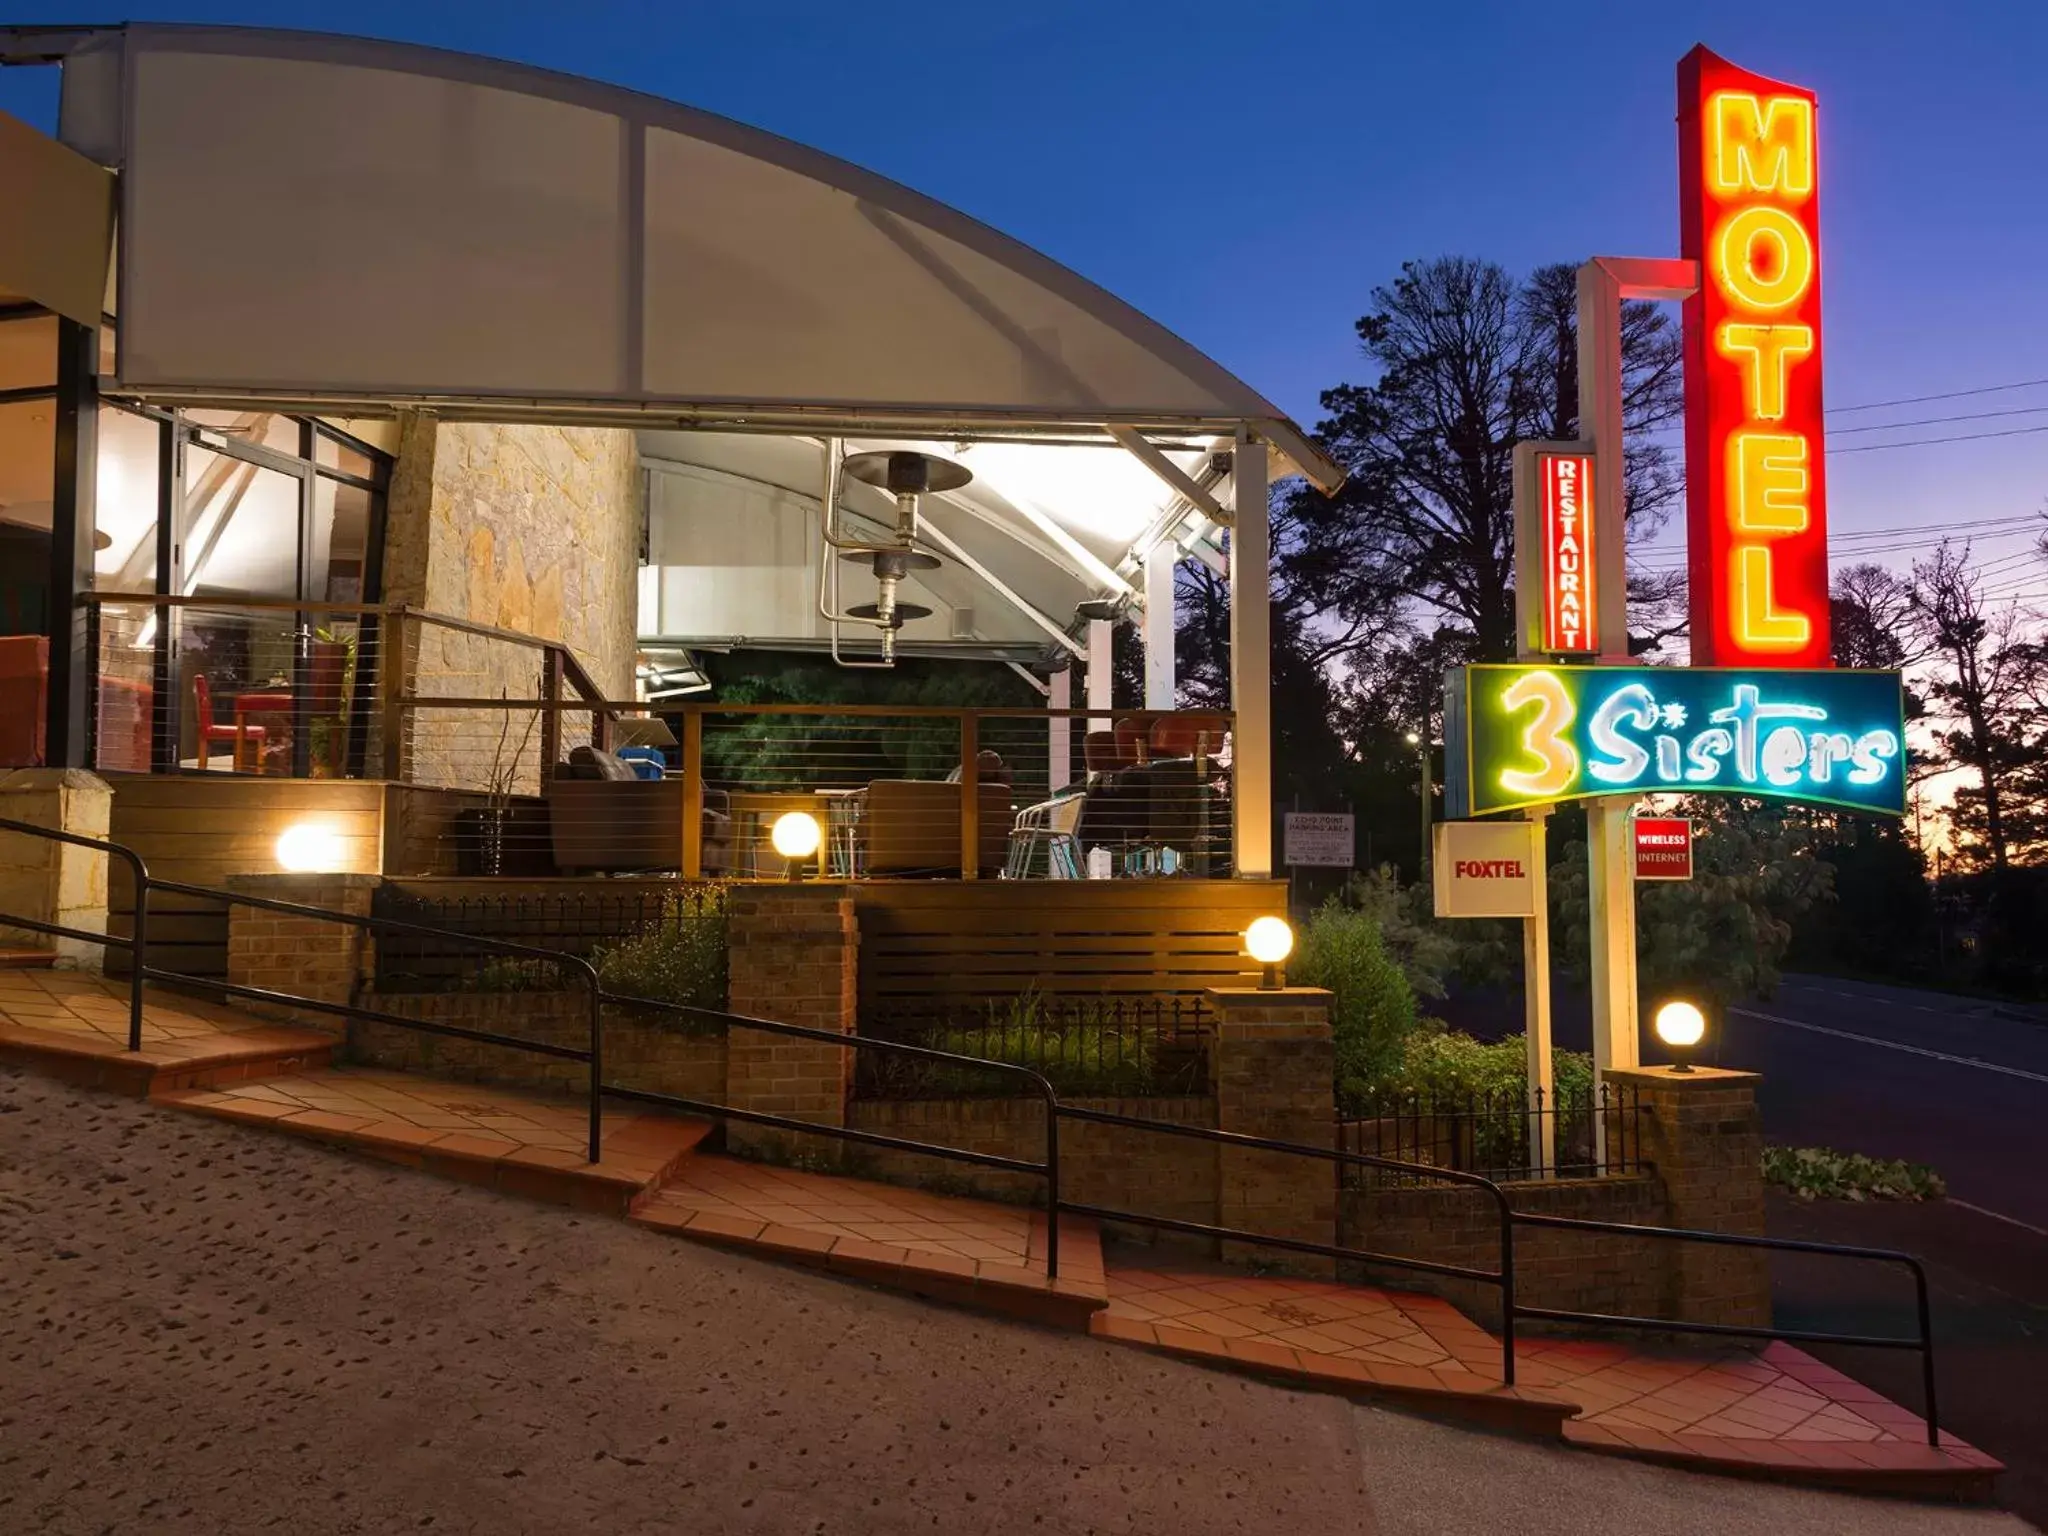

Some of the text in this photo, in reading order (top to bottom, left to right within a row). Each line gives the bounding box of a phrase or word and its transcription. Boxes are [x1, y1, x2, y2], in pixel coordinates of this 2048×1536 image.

[1713, 93, 1813, 645] MOTEL
[1556, 459, 1580, 649] RESTAURANT
[1501, 671, 1899, 795] 3 Sisters
[1455, 860, 1525, 879] FOXTEL
[1637, 834, 1686, 845] WIRELESS
[1638, 852, 1687, 863] INTERNET
